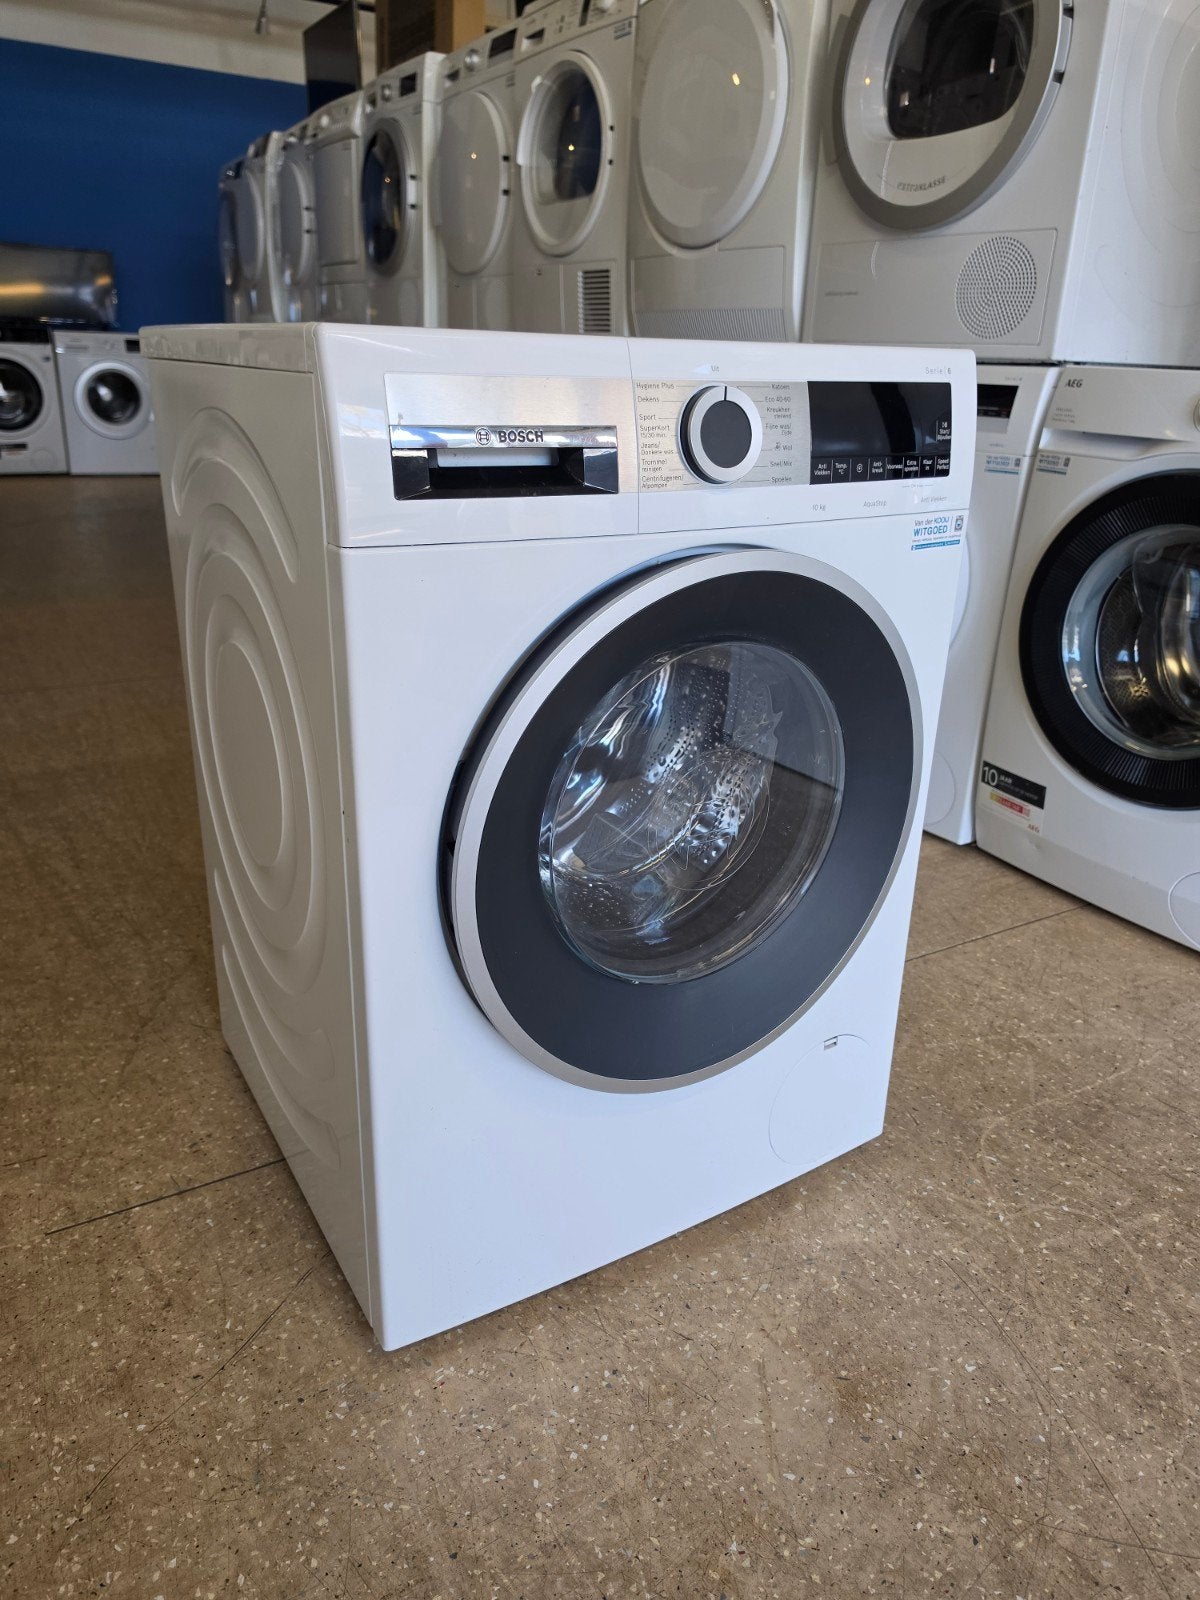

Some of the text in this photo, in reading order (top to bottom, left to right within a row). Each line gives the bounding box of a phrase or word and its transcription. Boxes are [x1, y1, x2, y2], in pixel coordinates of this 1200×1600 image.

[636, 382, 675, 391] Hygiene Plus
[1066, 379, 1083, 388] AEG
[637, 395, 660, 403] Dekens
[639, 413, 656, 421] Sport
[640, 424, 670, 433] SuperKort
[498, 430, 544, 443] BOSCH
[819, 503, 826, 512] kg
[914, 519, 924, 527] Van
[925, 518, 933, 526] der
[913, 525, 948, 537] WITGOED
[983, 766, 998, 786] 10
